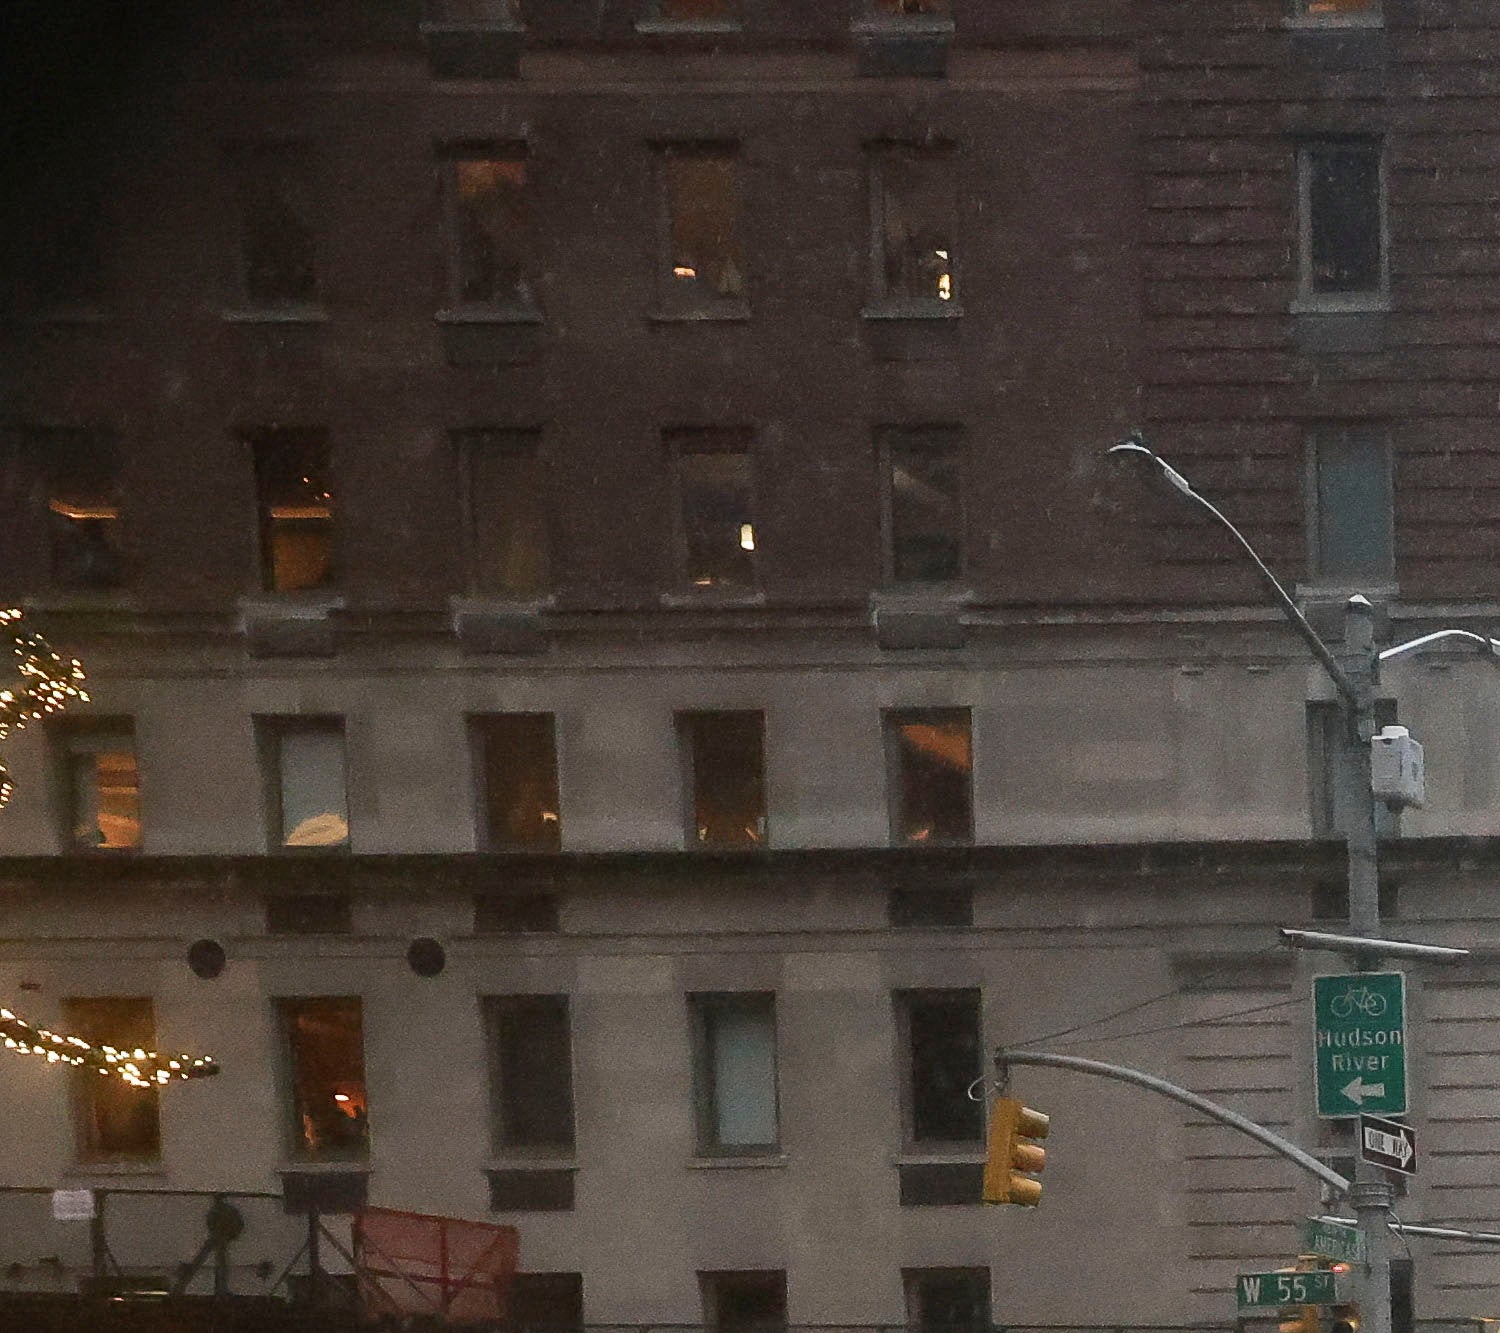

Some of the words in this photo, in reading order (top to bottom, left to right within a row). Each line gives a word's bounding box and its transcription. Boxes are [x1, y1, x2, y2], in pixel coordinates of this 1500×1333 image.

[1318, 1028, 1402, 1048] Hudson
[1332, 1053, 1390, 1072] River
[1368, 1130, 1385, 1152] ONE
[1392, 1137, 1409, 1159] WAY
[1242, 1277, 1260, 1303] W
[1277, 1276, 1306, 1303] 55
[1314, 1275, 1330, 1288] ST
